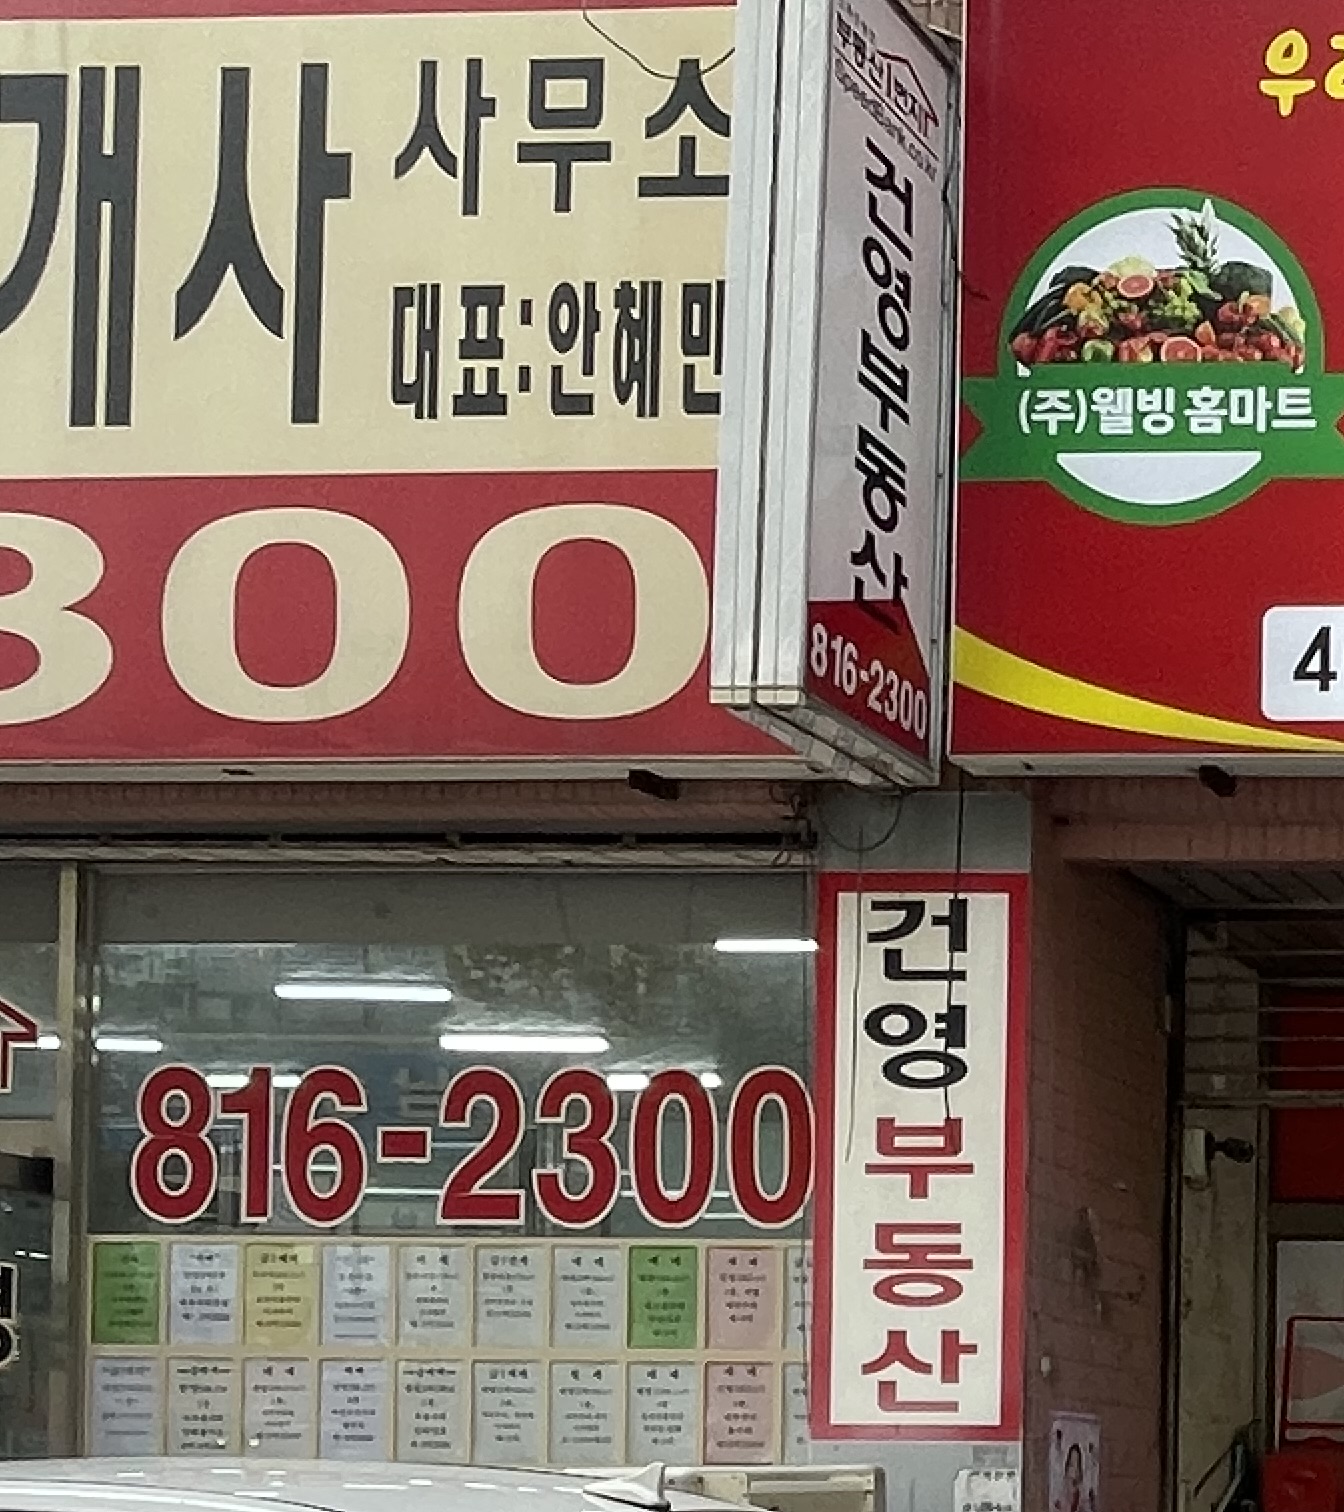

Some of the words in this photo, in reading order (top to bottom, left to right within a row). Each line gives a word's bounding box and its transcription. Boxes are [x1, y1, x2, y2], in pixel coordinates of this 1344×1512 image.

[394, 58, 730, 216] 사무소
[392, 280, 723, 419] 대표:안혜민
[849, 136, 916, 637] 건영부동산
[1017, 385, 1175, 436] (주)웰빙
[1183, 387, 1318, 433] 홈마트
[810, 622, 927, 740] 816-2300
[131, 1062, 816, 1229] 816-2300
[860, 898, 979, 1414] 건영부동산
